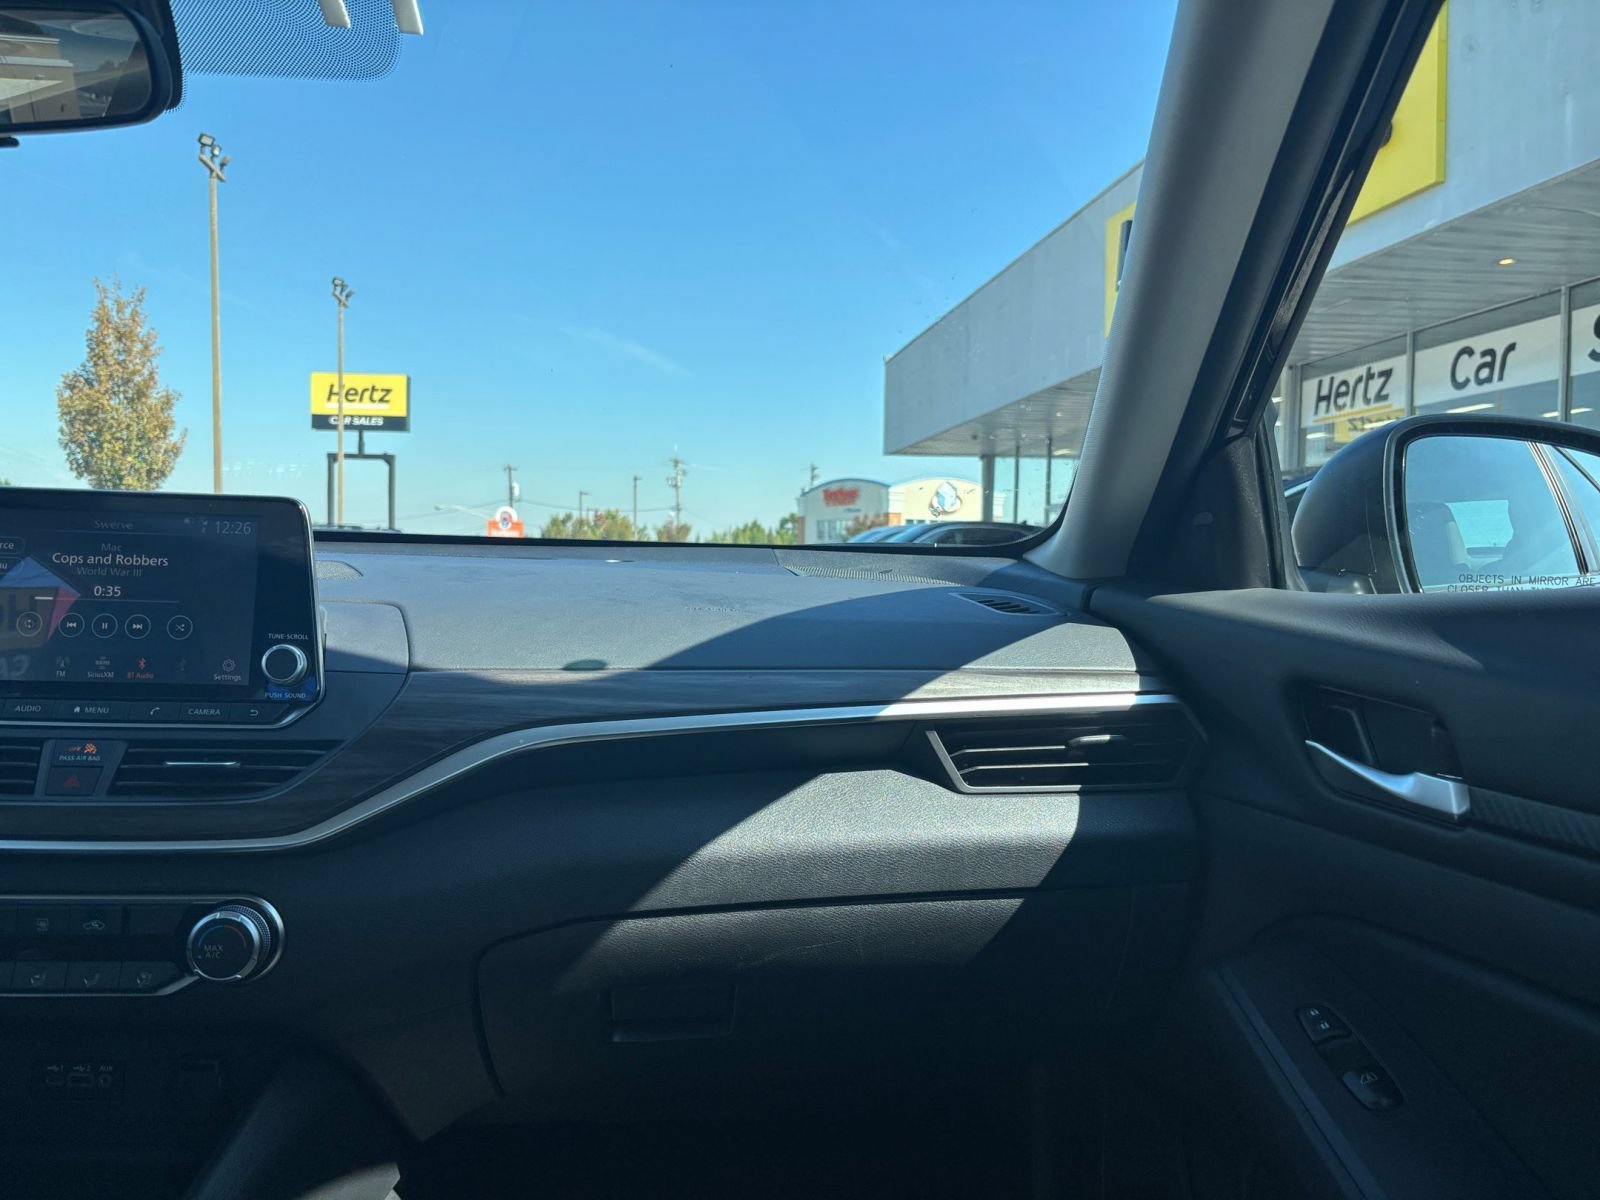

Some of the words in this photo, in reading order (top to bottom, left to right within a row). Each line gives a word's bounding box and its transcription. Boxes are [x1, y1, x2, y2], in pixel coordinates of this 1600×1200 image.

[1314, 365, 1393, 415] Hertz
[1450, 341, 1516, 391] Car
[326, 383, 392, 403] Hertz
[351, 416, 384, 426] SALES
[94, 520, 134, 529] Swerve
[215, 521, 252, 534] 12:26
[101, 543, 122, 552] Mac
[52, 552, 83, 566] Cops
[87, 553, 112, 565] and
[115, 554, 169, 567] Robbers
[77, 566, 109, 576] World
[110, 567, 130, 576] War
[1458, 574, 1504, 584] OBJECTS
[1511, 575, 1522, 585] IN
[1528, 575, 1569, 586] MIRROR
[1575, 576, 1596, 587] ARE
[93, 585, 121, 597] 0:35
[135, 672, 154, 680] Audio
[213, 673, 242, 682] Settings
[14, 705, 42, 713] AUDIO
[84, 706, 110, 714] MENU
[188, 708, 221, 716] CAMERA
